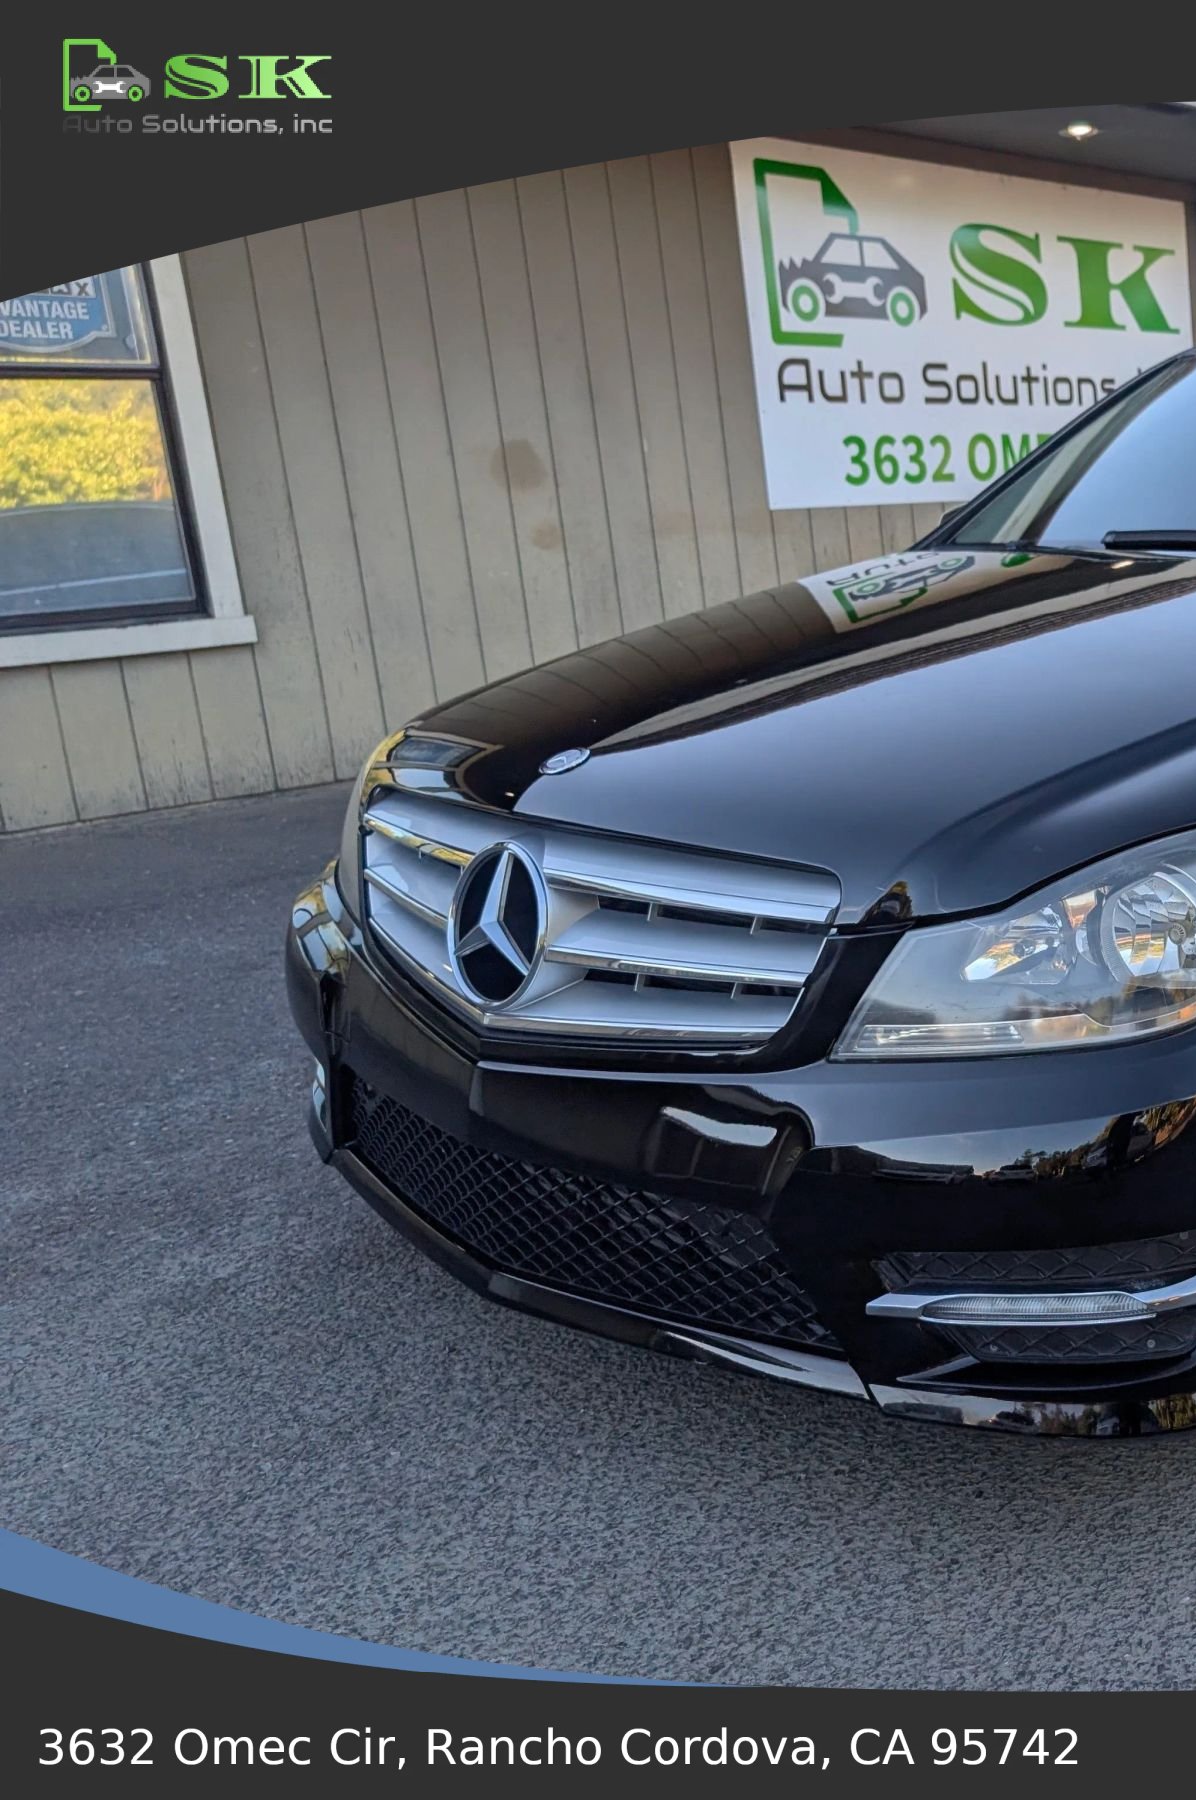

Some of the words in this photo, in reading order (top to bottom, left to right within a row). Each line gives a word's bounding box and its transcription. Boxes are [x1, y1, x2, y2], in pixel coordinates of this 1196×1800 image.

[950, 223, 1180, 334] SK
[777, 357, 906, 404] Auto
[843, 434, 956, 486] 3632
[968, 432, 1053, 482] OM
